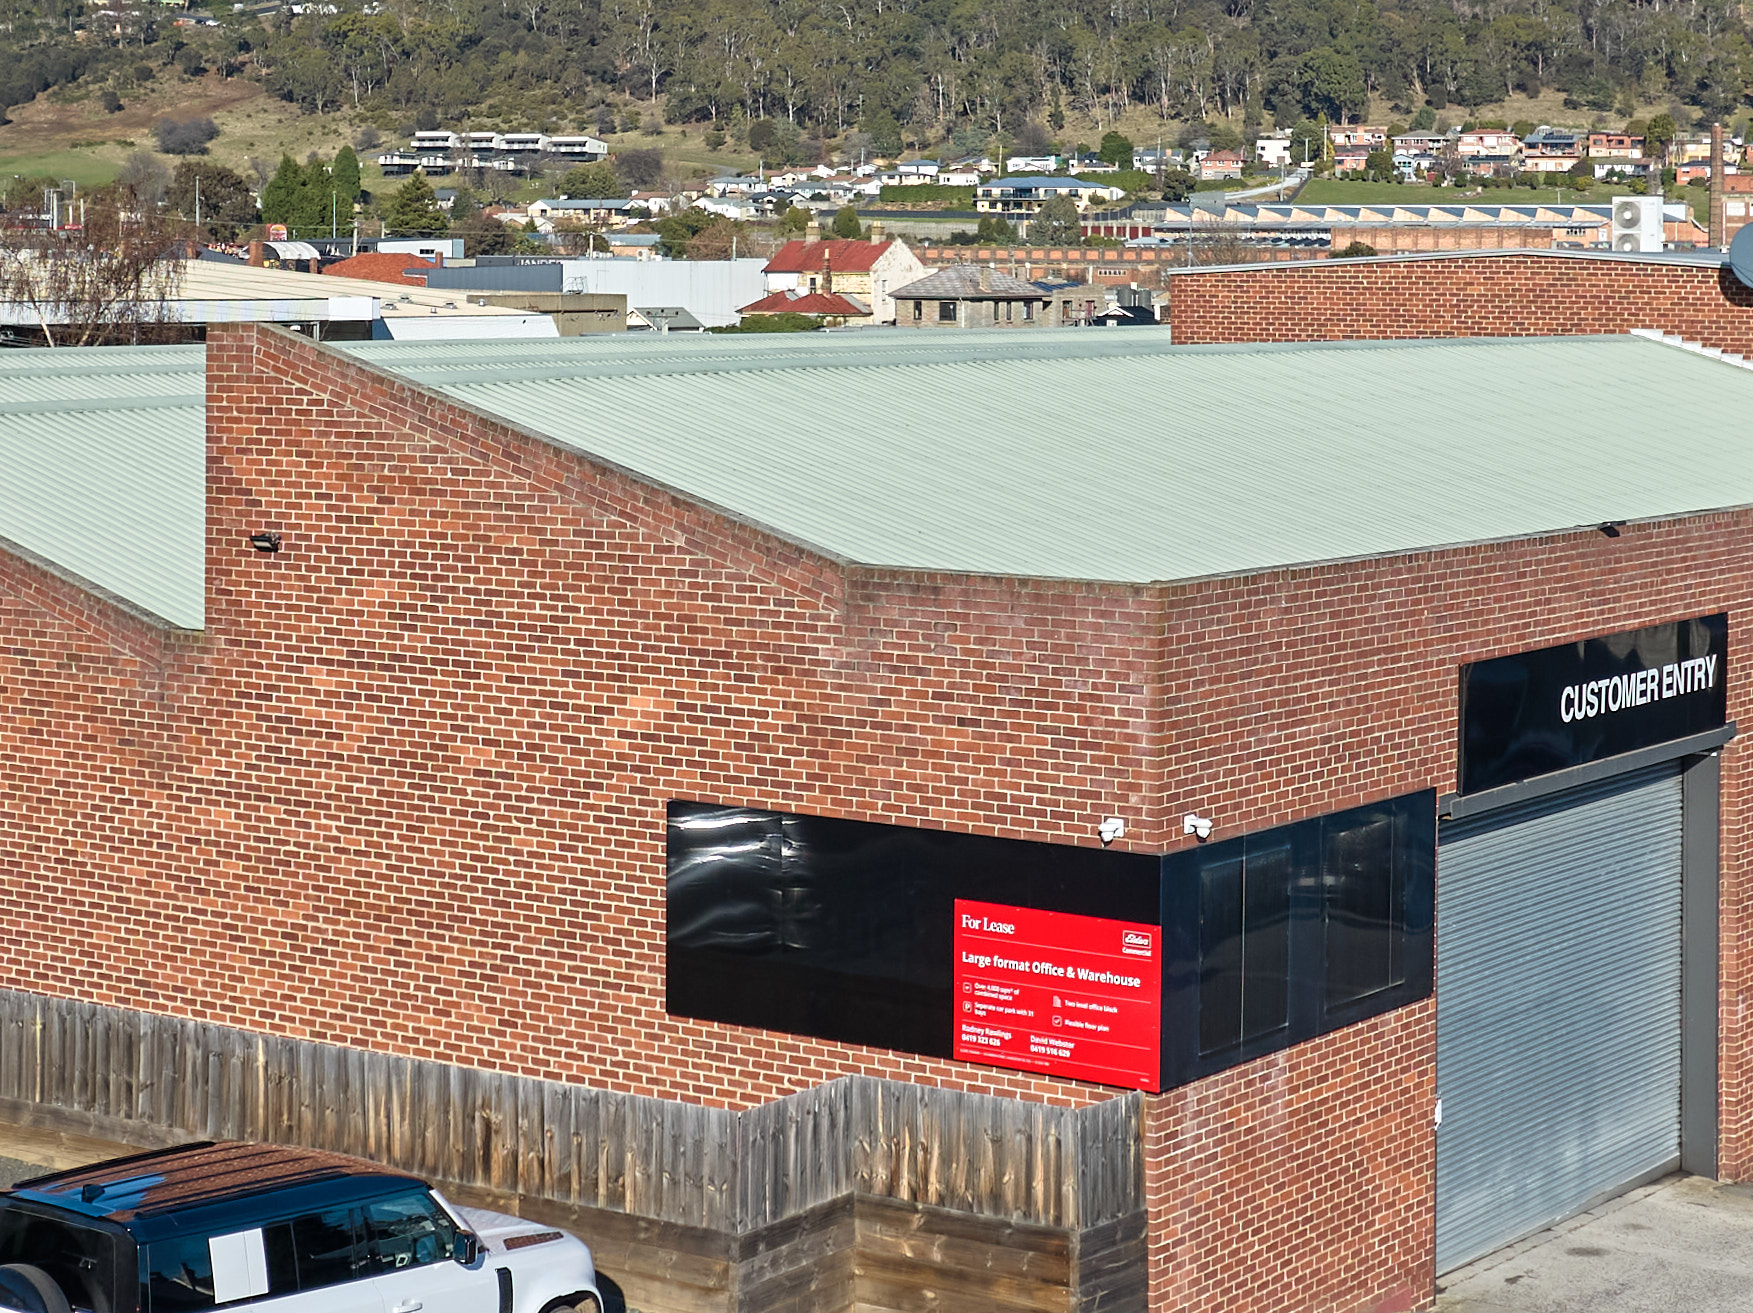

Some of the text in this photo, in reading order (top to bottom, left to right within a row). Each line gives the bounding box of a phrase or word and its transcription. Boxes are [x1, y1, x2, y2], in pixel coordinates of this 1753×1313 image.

[1560, 654, 1718, 723] CUSTOMER ENTRY
[961, 914, 1015, 935] For Lease
[961, 951, 1141, 988] Large format Office & Warehouse
[1030, 1035, 1048, 1045] David
[1030, 1044, 1046, 1054] 0419
